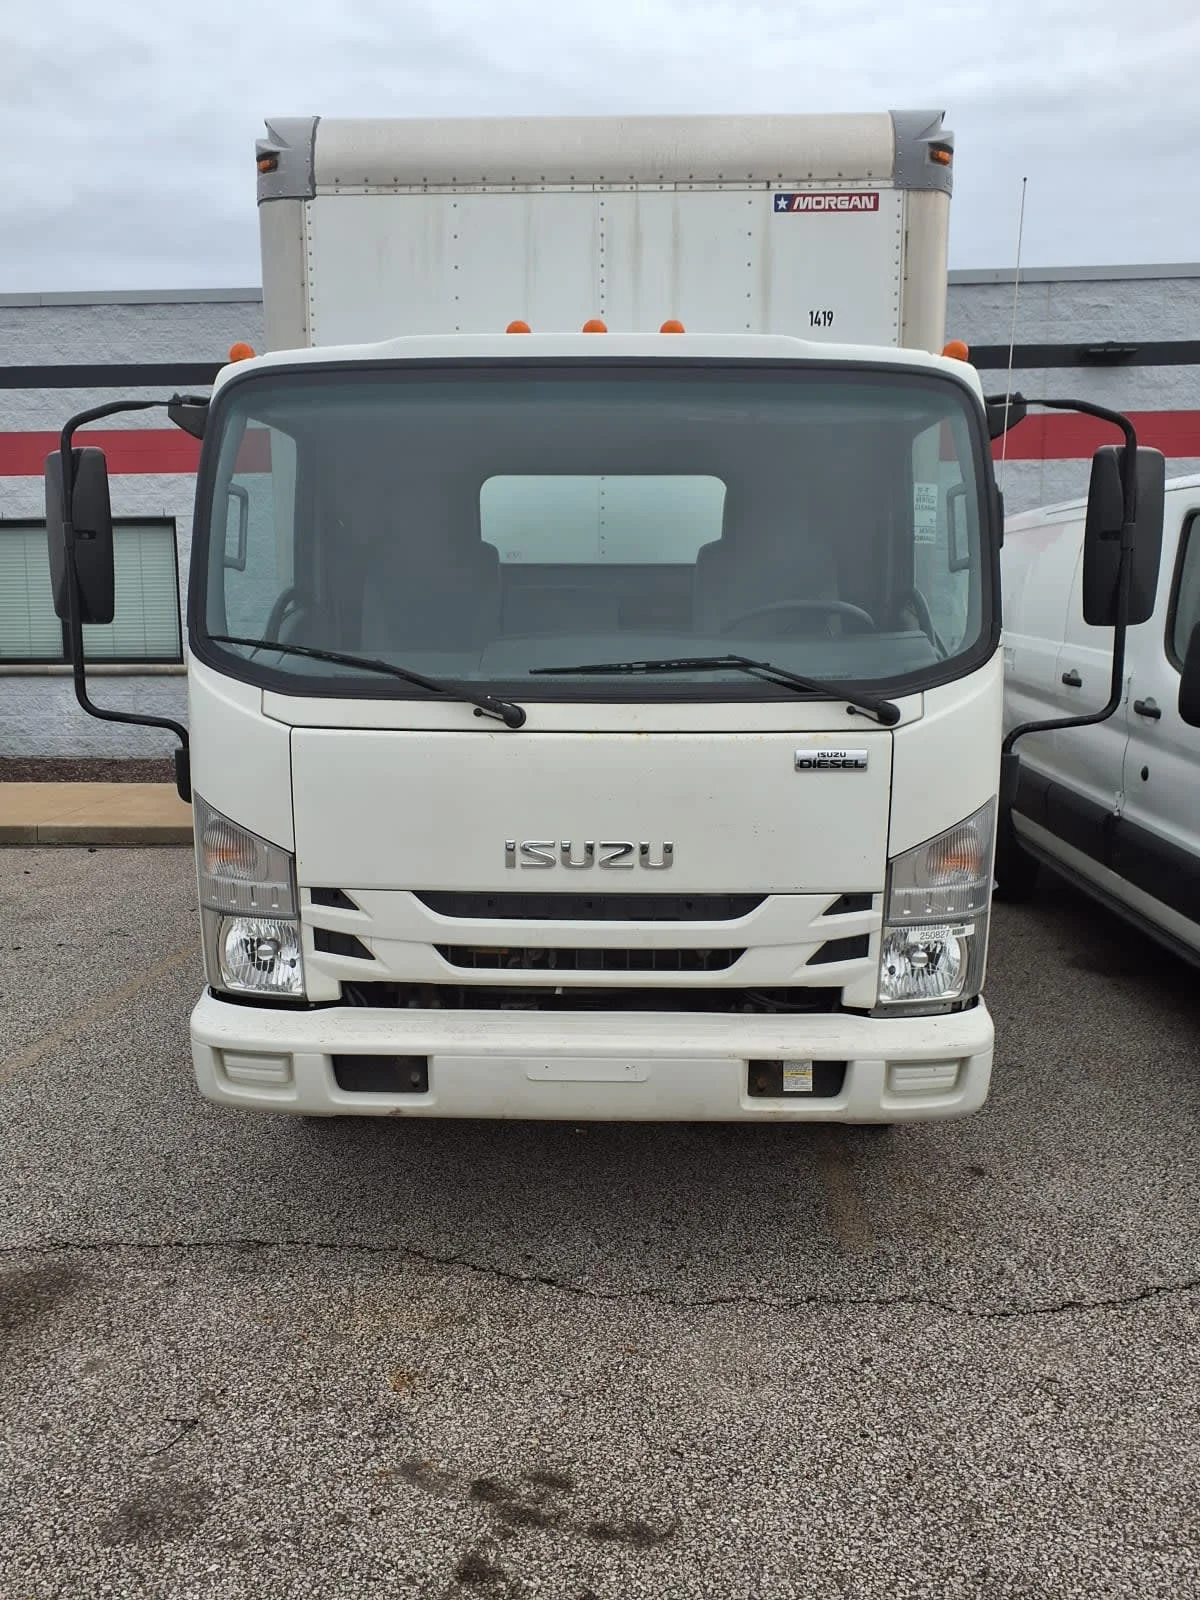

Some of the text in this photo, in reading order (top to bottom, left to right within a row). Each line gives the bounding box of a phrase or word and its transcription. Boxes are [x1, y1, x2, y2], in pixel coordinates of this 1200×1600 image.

[793, 196, 875, 210] MORGAN
[808, 310, 834, 327] 1419
[799, 759, 866, 769] DIESEL
[504, 839, 674, 870] ISUZU
